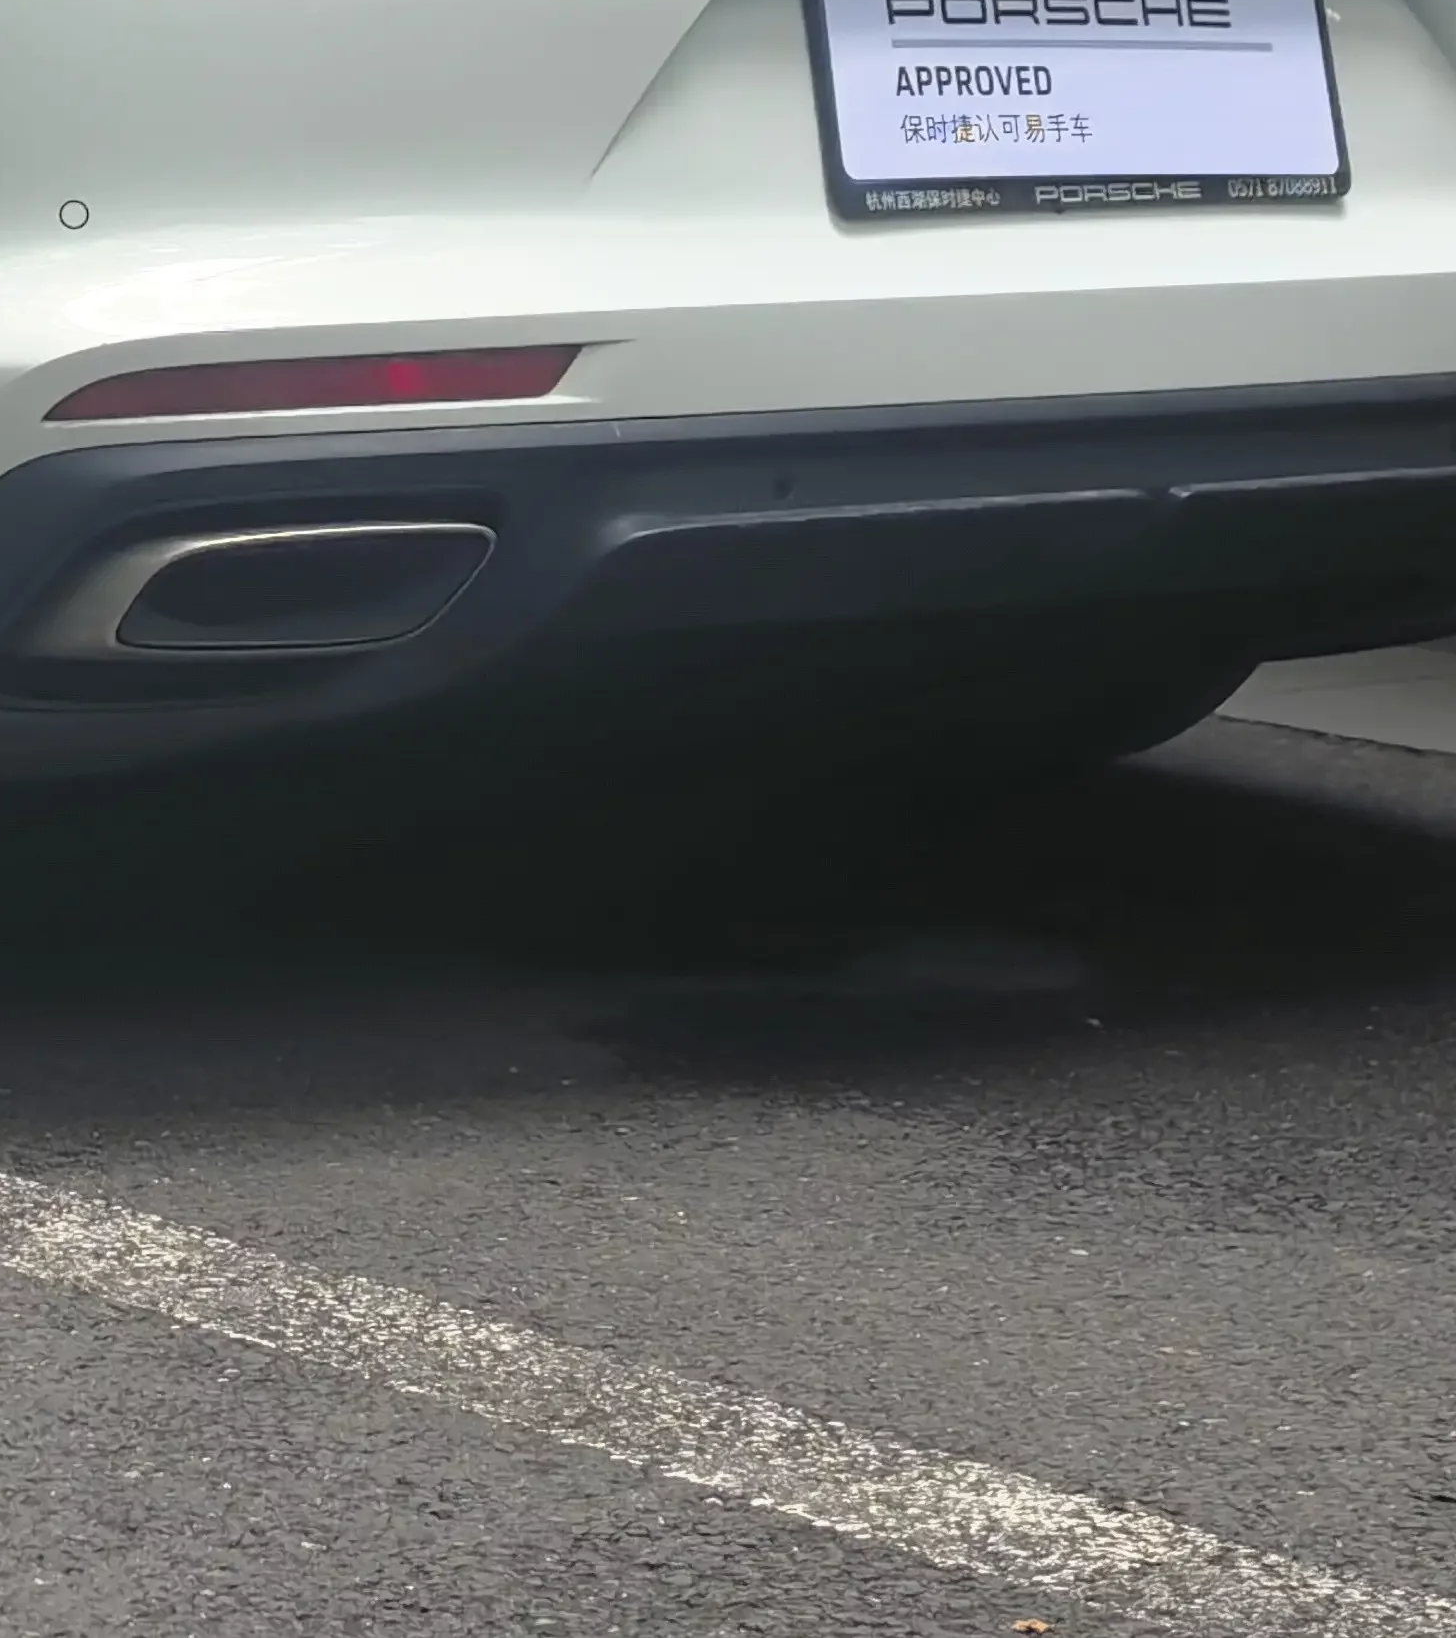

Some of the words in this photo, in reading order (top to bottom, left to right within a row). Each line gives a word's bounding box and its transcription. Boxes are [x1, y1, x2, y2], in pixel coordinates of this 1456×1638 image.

[895, 64, 1053, 98] APPROVED
[899, 112, 1094, 145] 保时捷认可易手车
[865, 185, 1002, 212] 杭州西湖保时捷中心
[1033, 180, 1203, 205] PORSCHE
